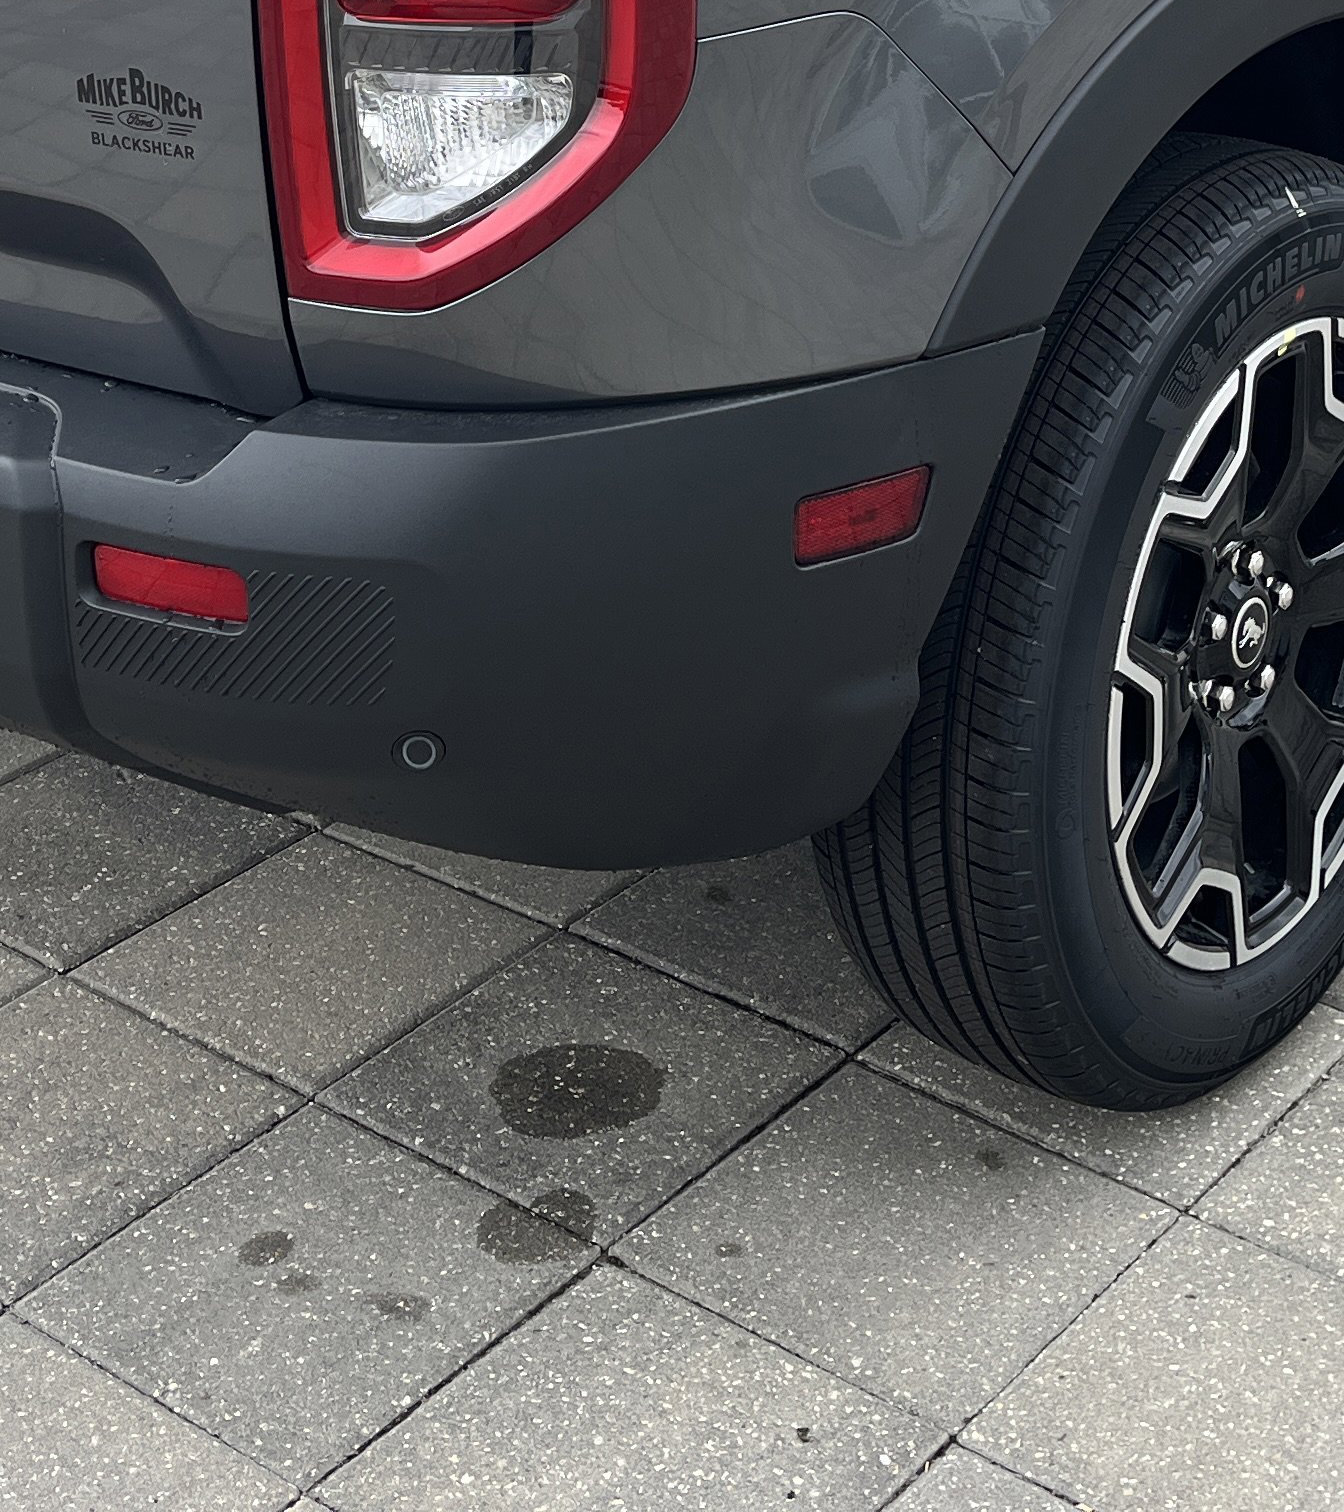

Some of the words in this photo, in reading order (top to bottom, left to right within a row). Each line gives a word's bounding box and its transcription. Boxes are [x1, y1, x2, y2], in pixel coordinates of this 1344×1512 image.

[126, 111, 155, 129] Ford
[90, 131, 195, 160] BLACKSHEAR
[1215, 233, 1343, 348] MICHELIN
